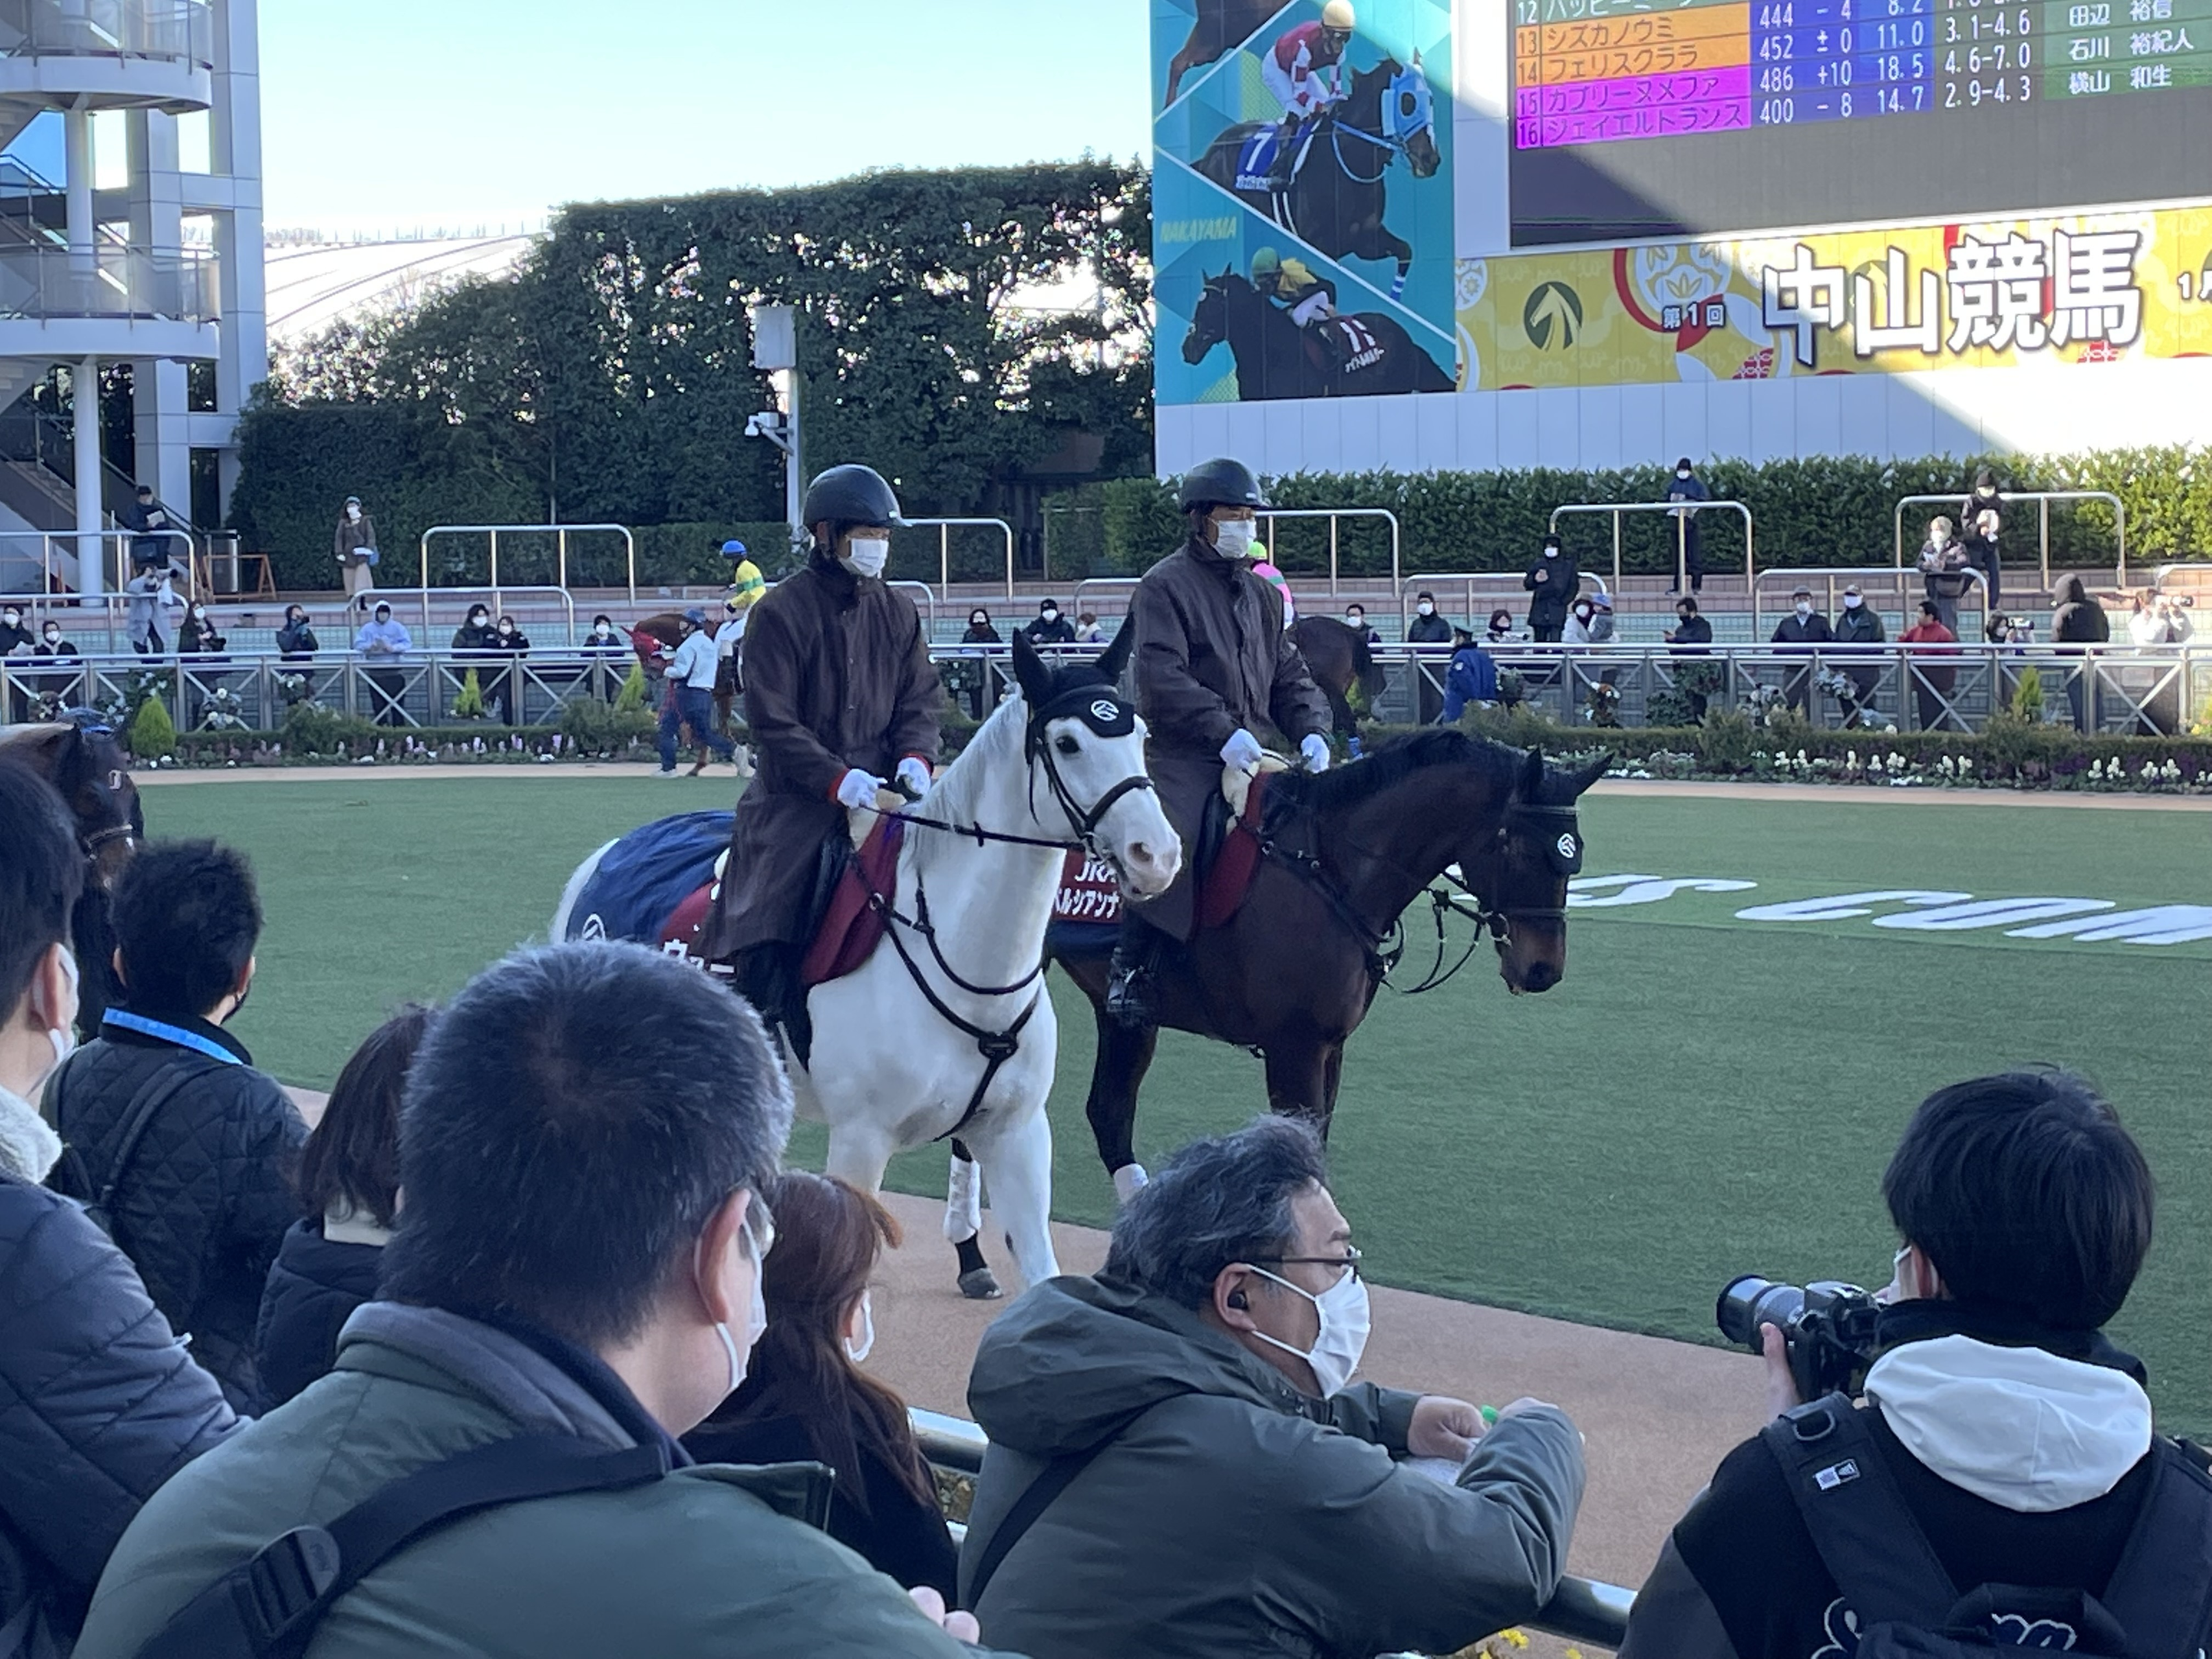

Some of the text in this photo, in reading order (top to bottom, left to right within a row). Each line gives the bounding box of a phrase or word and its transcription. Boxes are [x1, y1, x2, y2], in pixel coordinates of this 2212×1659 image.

[1518, 0, 1538, 24] 12
[1519, 30, 1537, 56] 13
[1547, 17, 1673, 51] シズカノウミ
[1760, 3, 1793, 29] 444
[2069, 3, 2111, 27] 田辺
[1518, 61, 1537, 84] 14
[1547, 44, 1697, 82] フェリスクララ
[1760, 34, 1793, 60] 452
[1878, 21, 1924, 50] 11.0
[2067, 36, 2110, 61] 石川
[1519, 91, 1539, 116] 15
[1760, 65, 1793, 92] 486
[1878, 53, 1924, 80] 18.5
[2068, 64, 2173, 95] 横山 和生
[1519, 121, 1539, 146] 16
[1548, 104, 1743, 143] ジェイエルトランス
[1760, 98, 1793, 124] 400
[1878, 86, 1924, 114] 14.7
[1245, 132, 1274, 172] 7
[1161, 216, 1237, 243] NAKAYAMA
[1662, 302, 1725, 329] 第1回
[1762, 227, 2143, 367] 中山競馬
